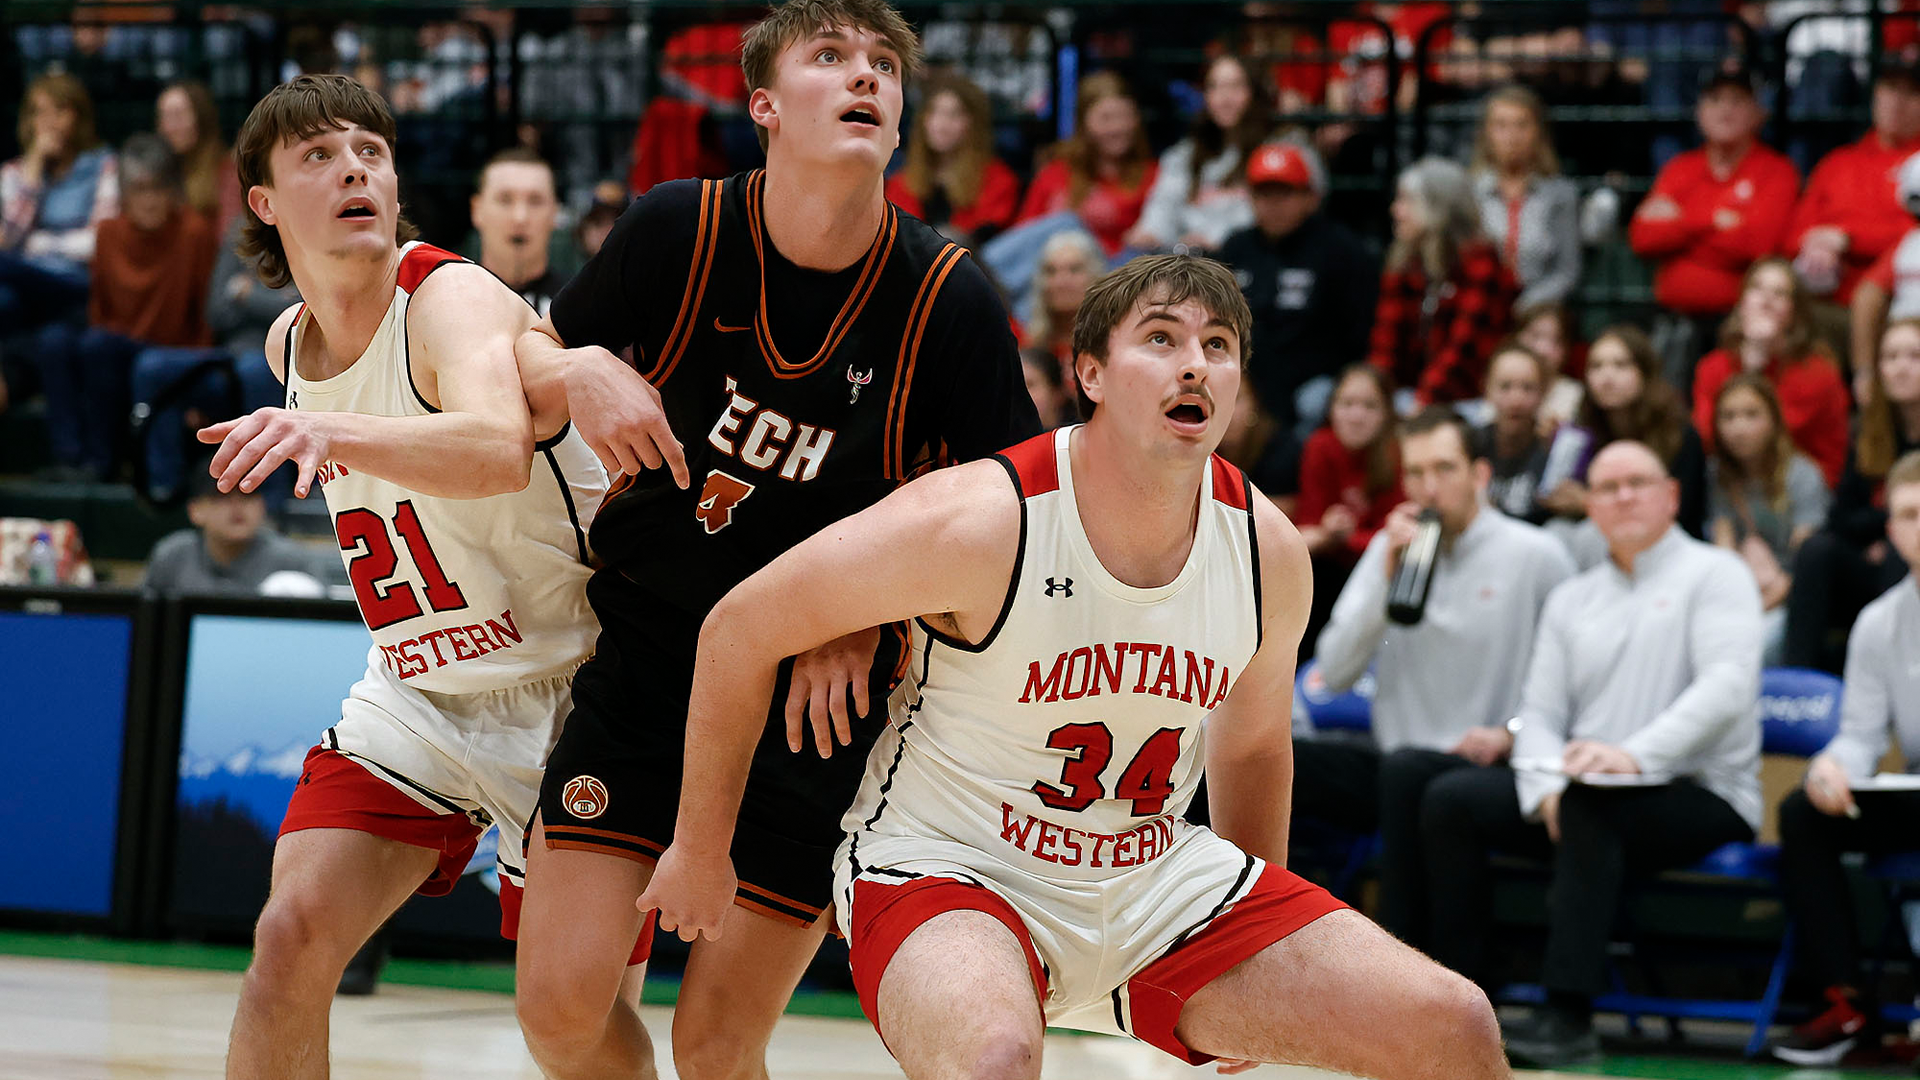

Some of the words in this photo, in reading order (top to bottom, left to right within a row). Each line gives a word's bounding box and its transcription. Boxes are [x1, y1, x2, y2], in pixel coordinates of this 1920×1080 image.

[707, 374, 837, 482] ECH
[696, 469, 756, 534] 4
[335, 499, 469, 631] 21
[1018, 642, 1228, 710] MONTANA
[1031, 721, 1186, 817] 34
